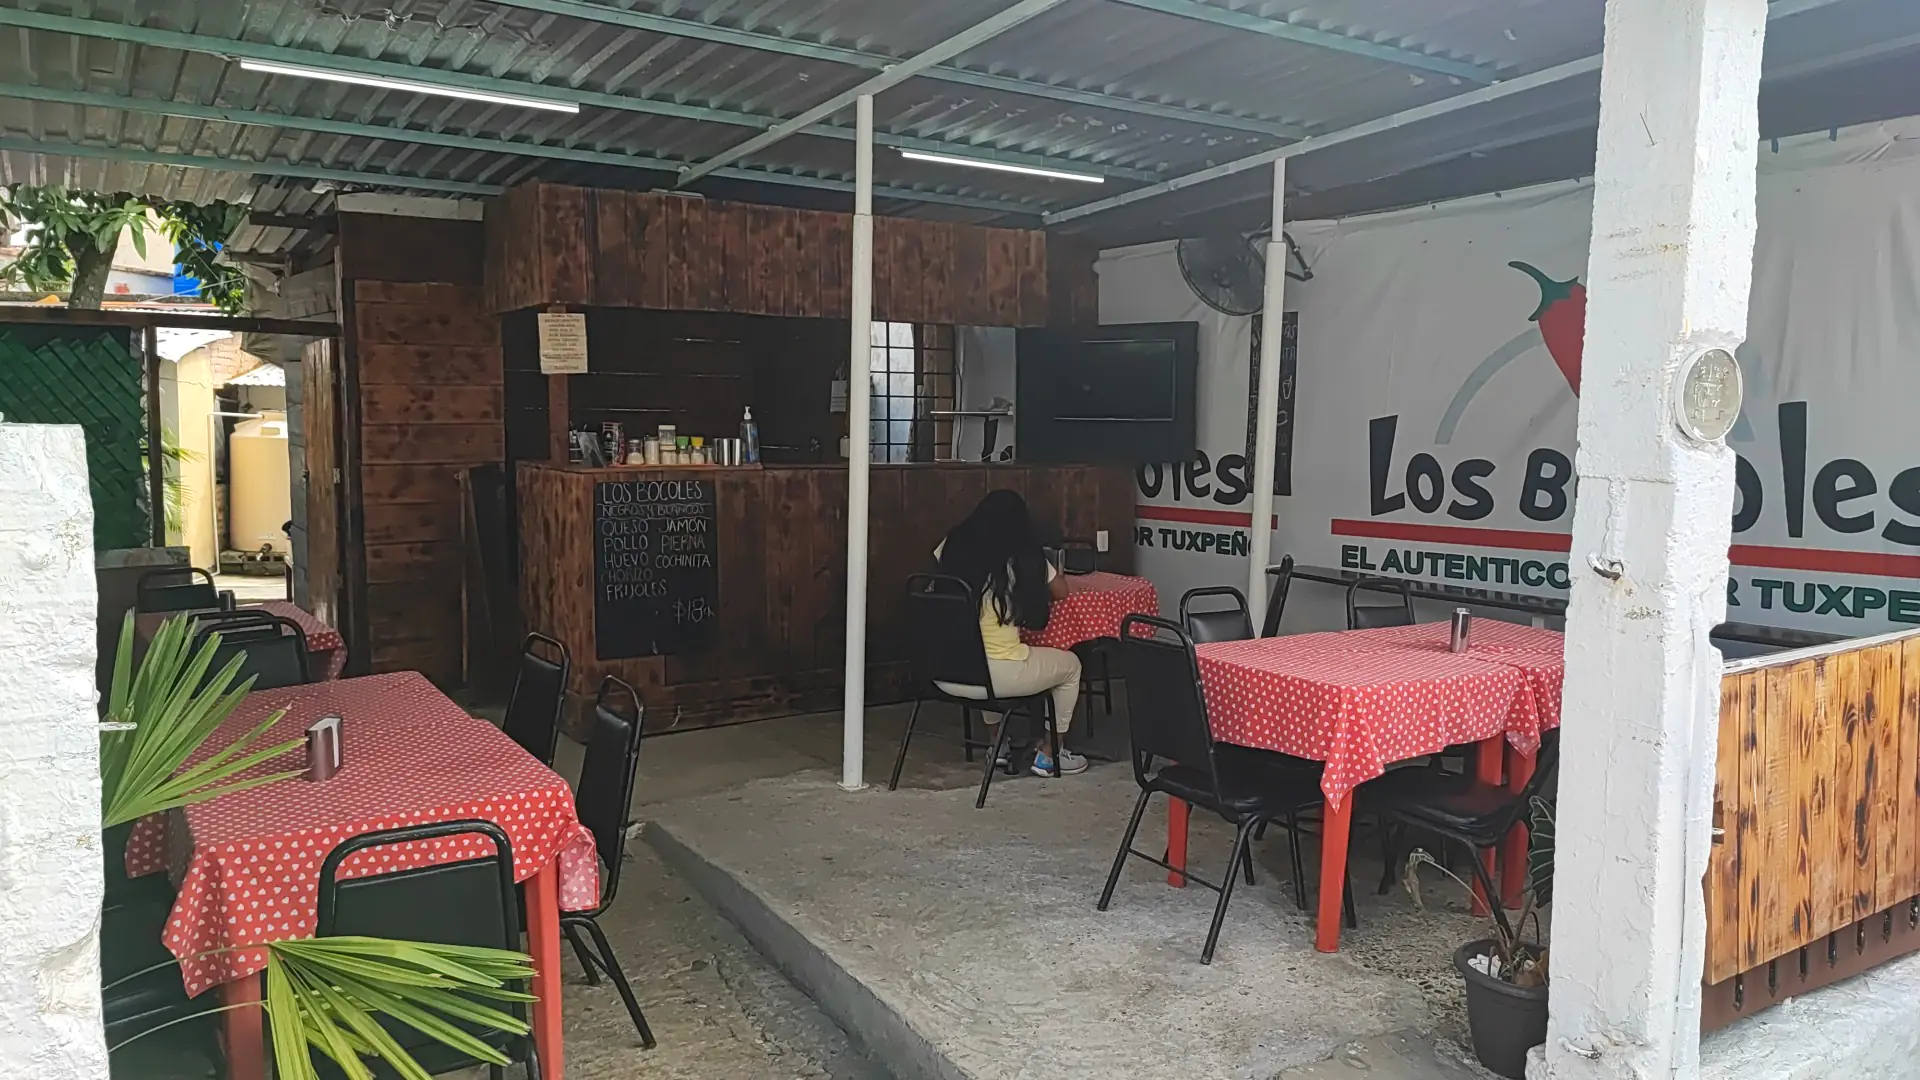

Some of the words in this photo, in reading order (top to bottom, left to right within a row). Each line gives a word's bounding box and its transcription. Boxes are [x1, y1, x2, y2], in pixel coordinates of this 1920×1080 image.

[602, 482, 632, 505] LOS
[636, 480, 703, 502] BOCOLES
[601, 505, 644, 517] NEGROS
[601, 519, 649, 537] QUESO
[658, 517, 707, 533] JAMÓN
[603, 534, 648, 553] POLLO
[661, 534, 706, 554] PIERNA
[1158, 527, 1252, 557] TUXPEÑ
[604, 552, 649, 569] HUEVO
[655, 553, 712, 569] COCHINITA
[1341, 544, 1377, 570] EL
[1380, 549, 1571, 589] AUTENTICO
[600, 567, 653, 584] CHORIZO
[606, 579, 669, 602] FRIJOLES
[1751, 578, 1920, 624] TUXPE
